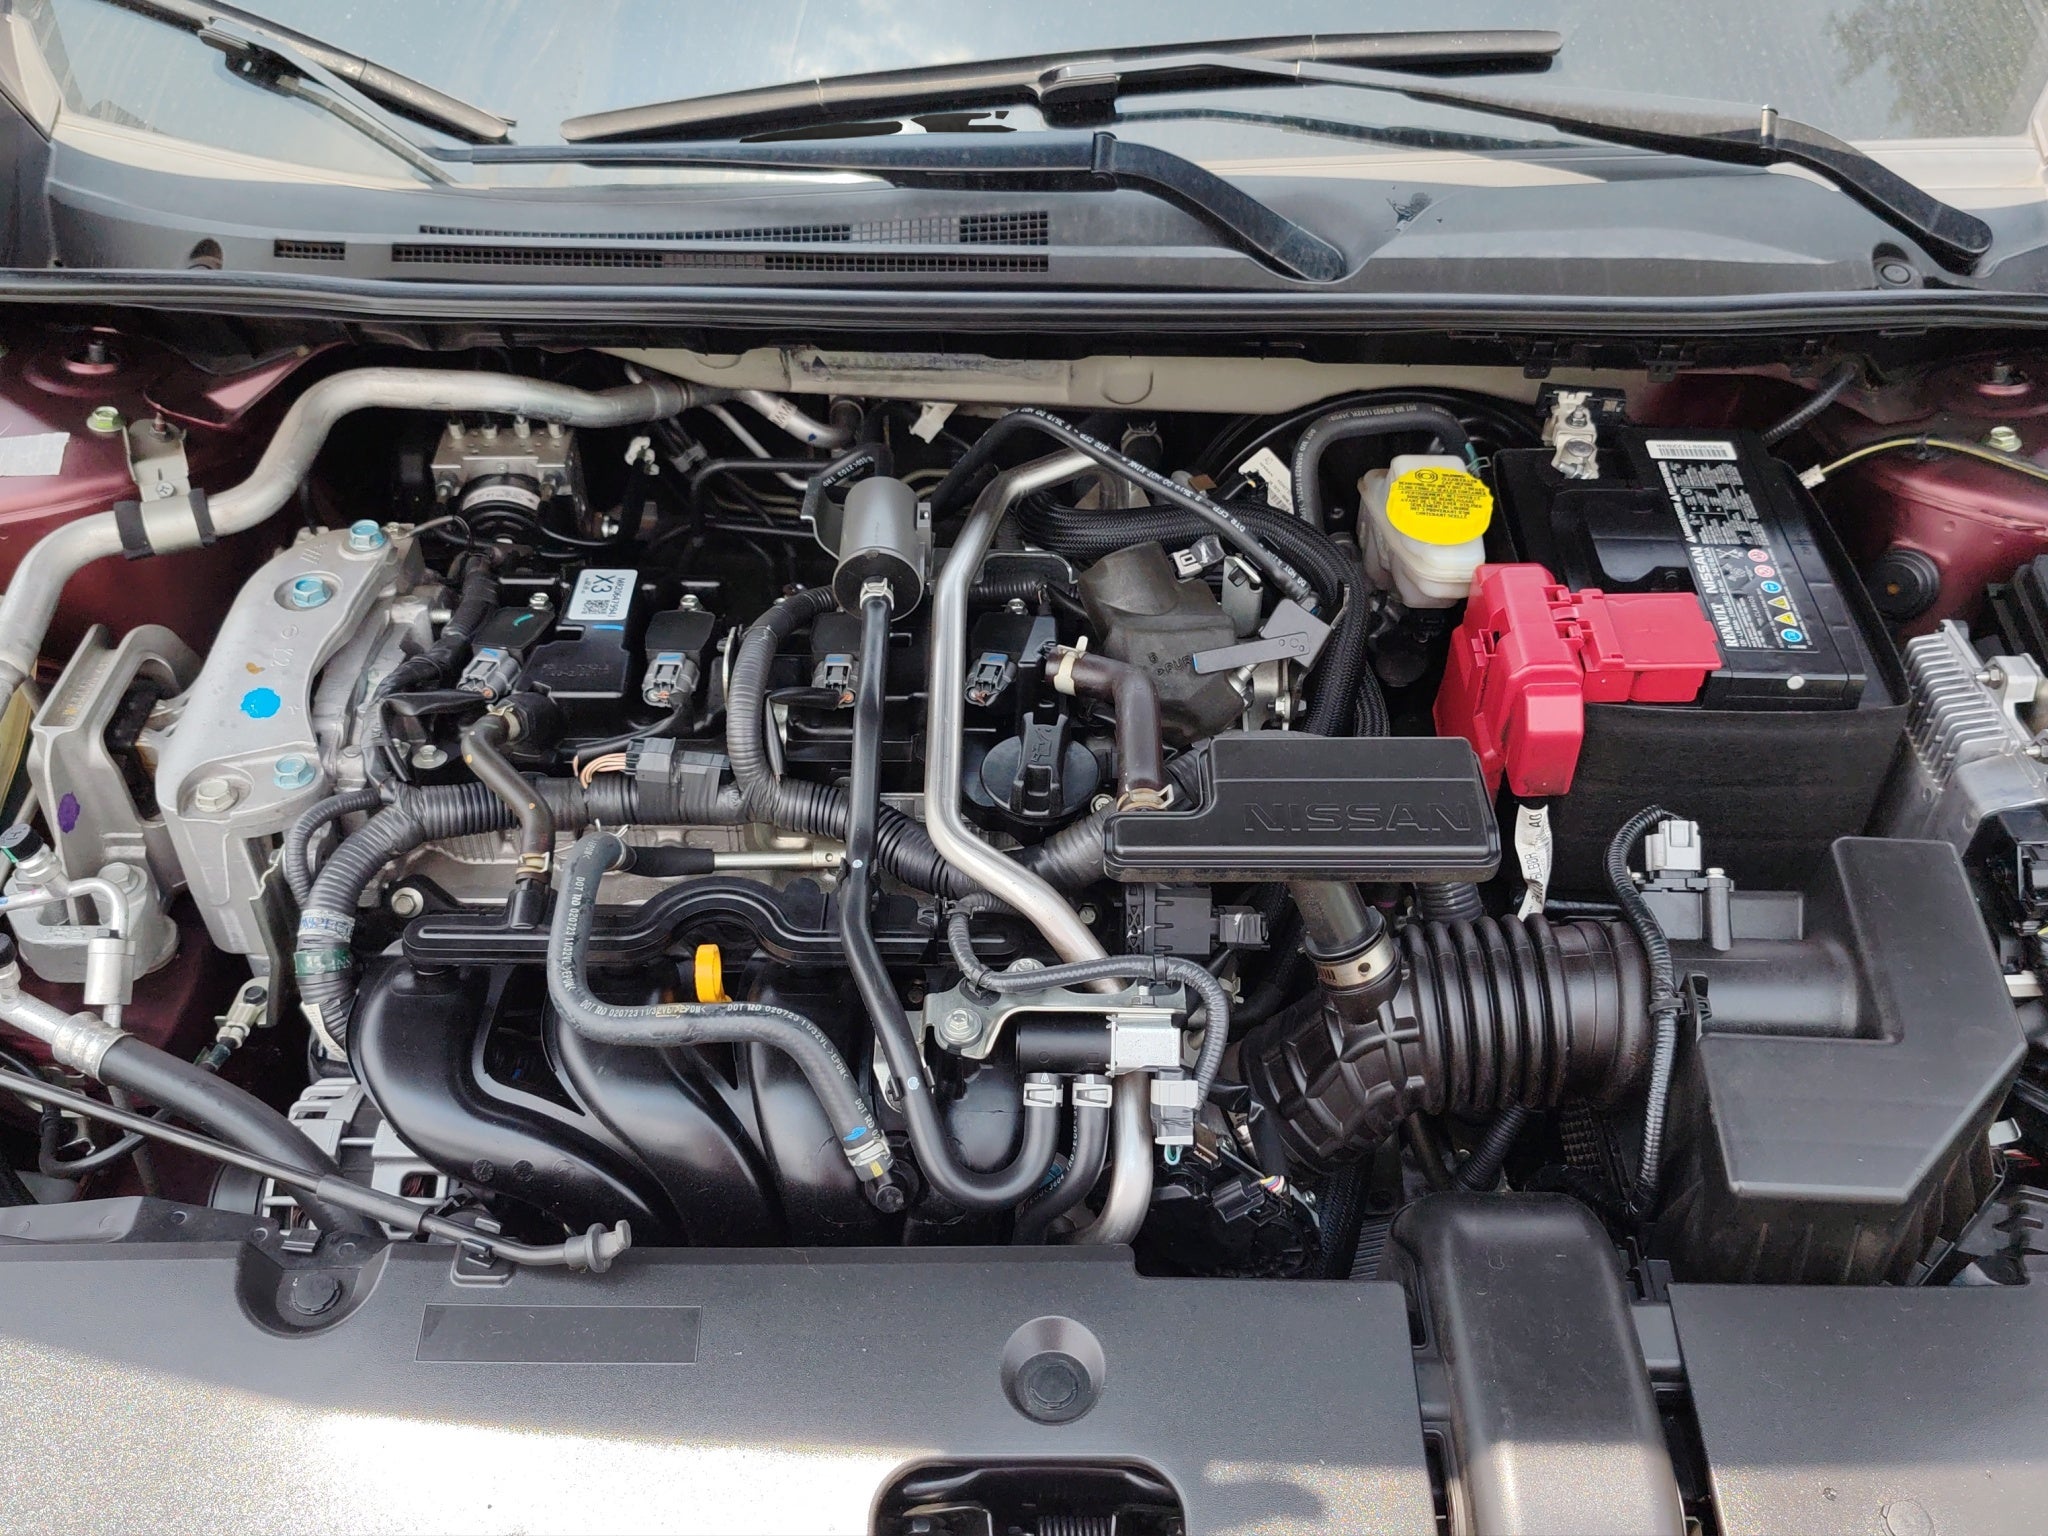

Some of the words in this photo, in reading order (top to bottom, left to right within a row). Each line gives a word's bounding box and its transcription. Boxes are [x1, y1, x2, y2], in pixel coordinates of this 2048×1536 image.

[1212, 506, 1229, 518] CFP
[1230, 518, 1246, 533] DTR
[1690, 547, 1719, 593] NISSAN
[591, 575, 616, 593] X3
[1711, 602, 1739, 647] RENAULT
[1243, 803, 1471, 832] NISSAN
[576, 876, 586, 892] DOT
[565, 907, 580, 936] 020723
[579, 999, 596, 1013] DOT
[608, 1007, 639, 1018] 020723
[727, 1003, 744, 1012] DOT
[764, 1005, 800, 1022] 020723
[854, 1097, 868, 1116] DOT
